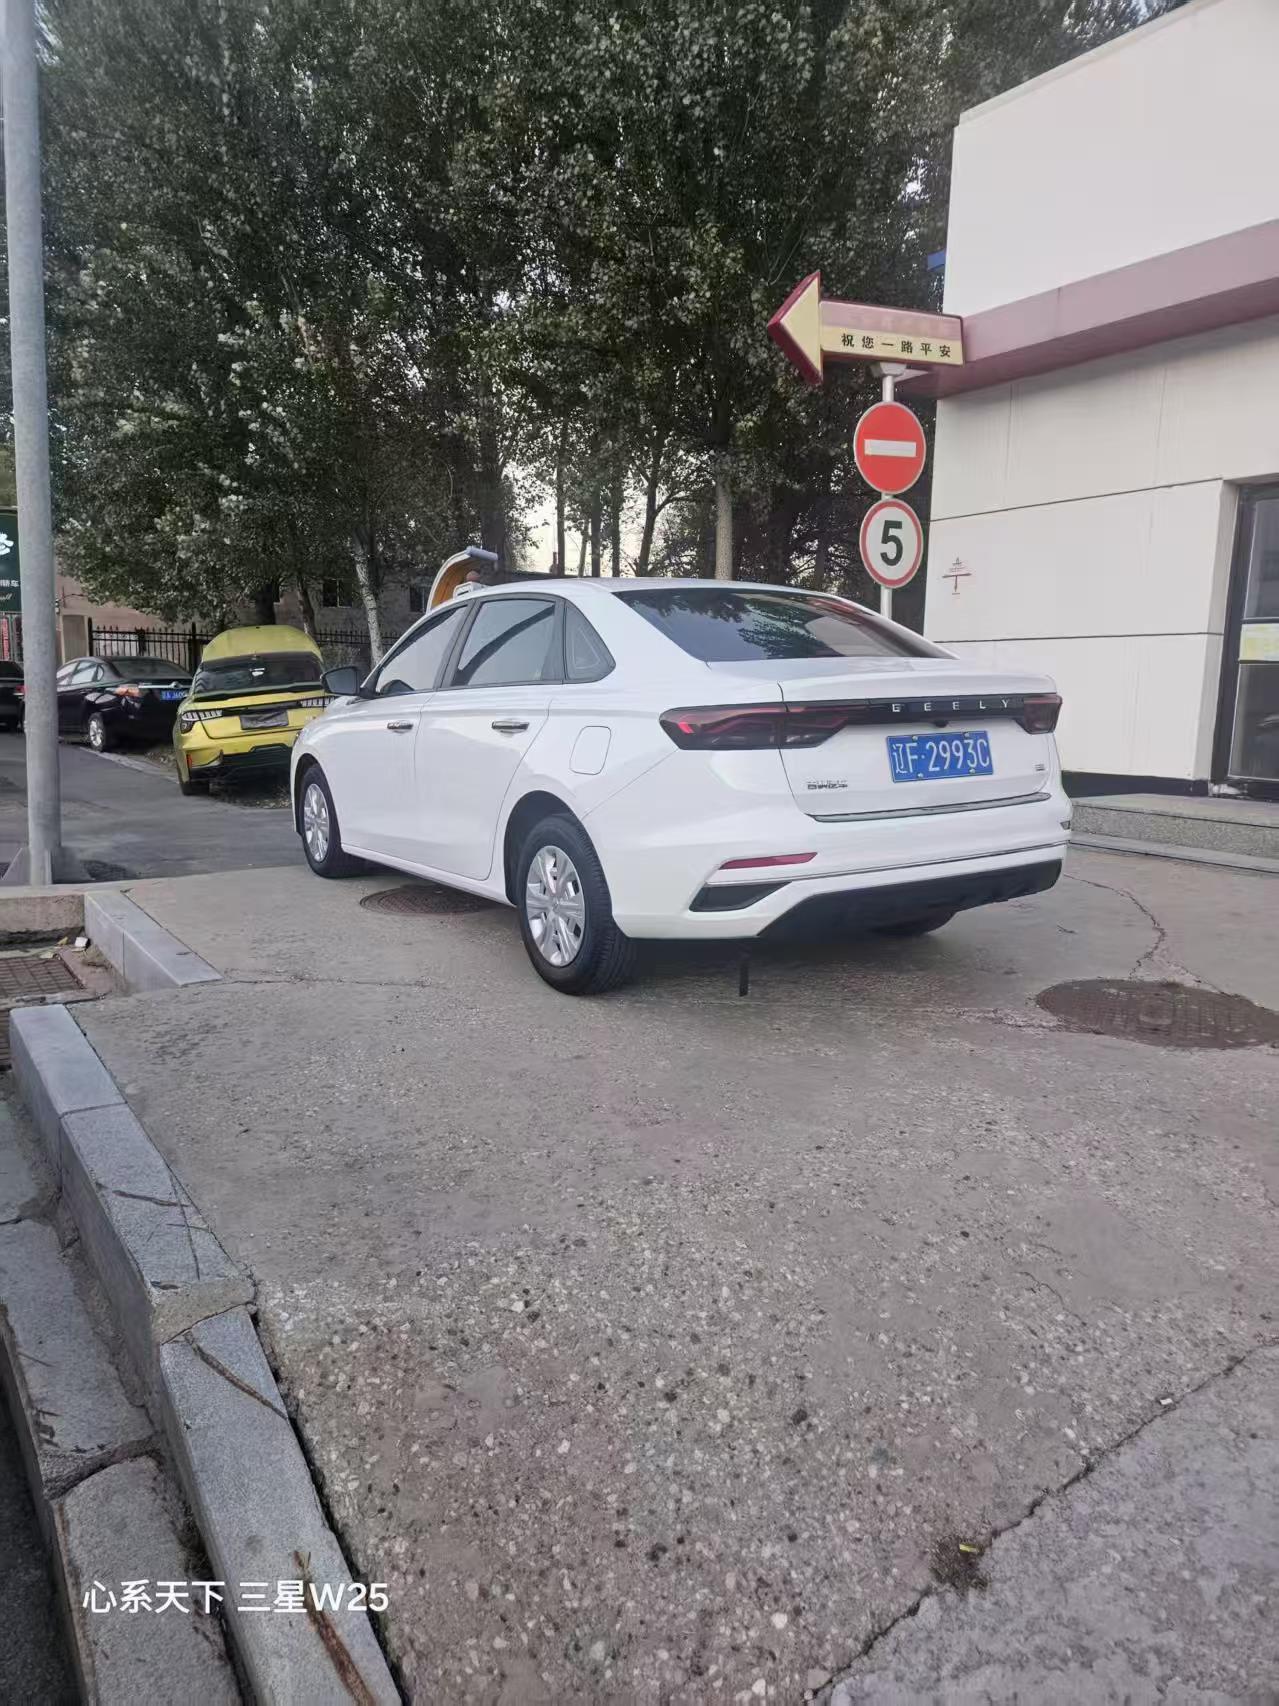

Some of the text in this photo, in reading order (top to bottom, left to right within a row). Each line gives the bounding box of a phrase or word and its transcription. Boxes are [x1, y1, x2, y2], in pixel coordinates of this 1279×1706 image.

[841, 333, 951, 358] 祝您一路平安
[880, 519, 904, 567] 5
[892, 700, 1009, 712] GEELY
